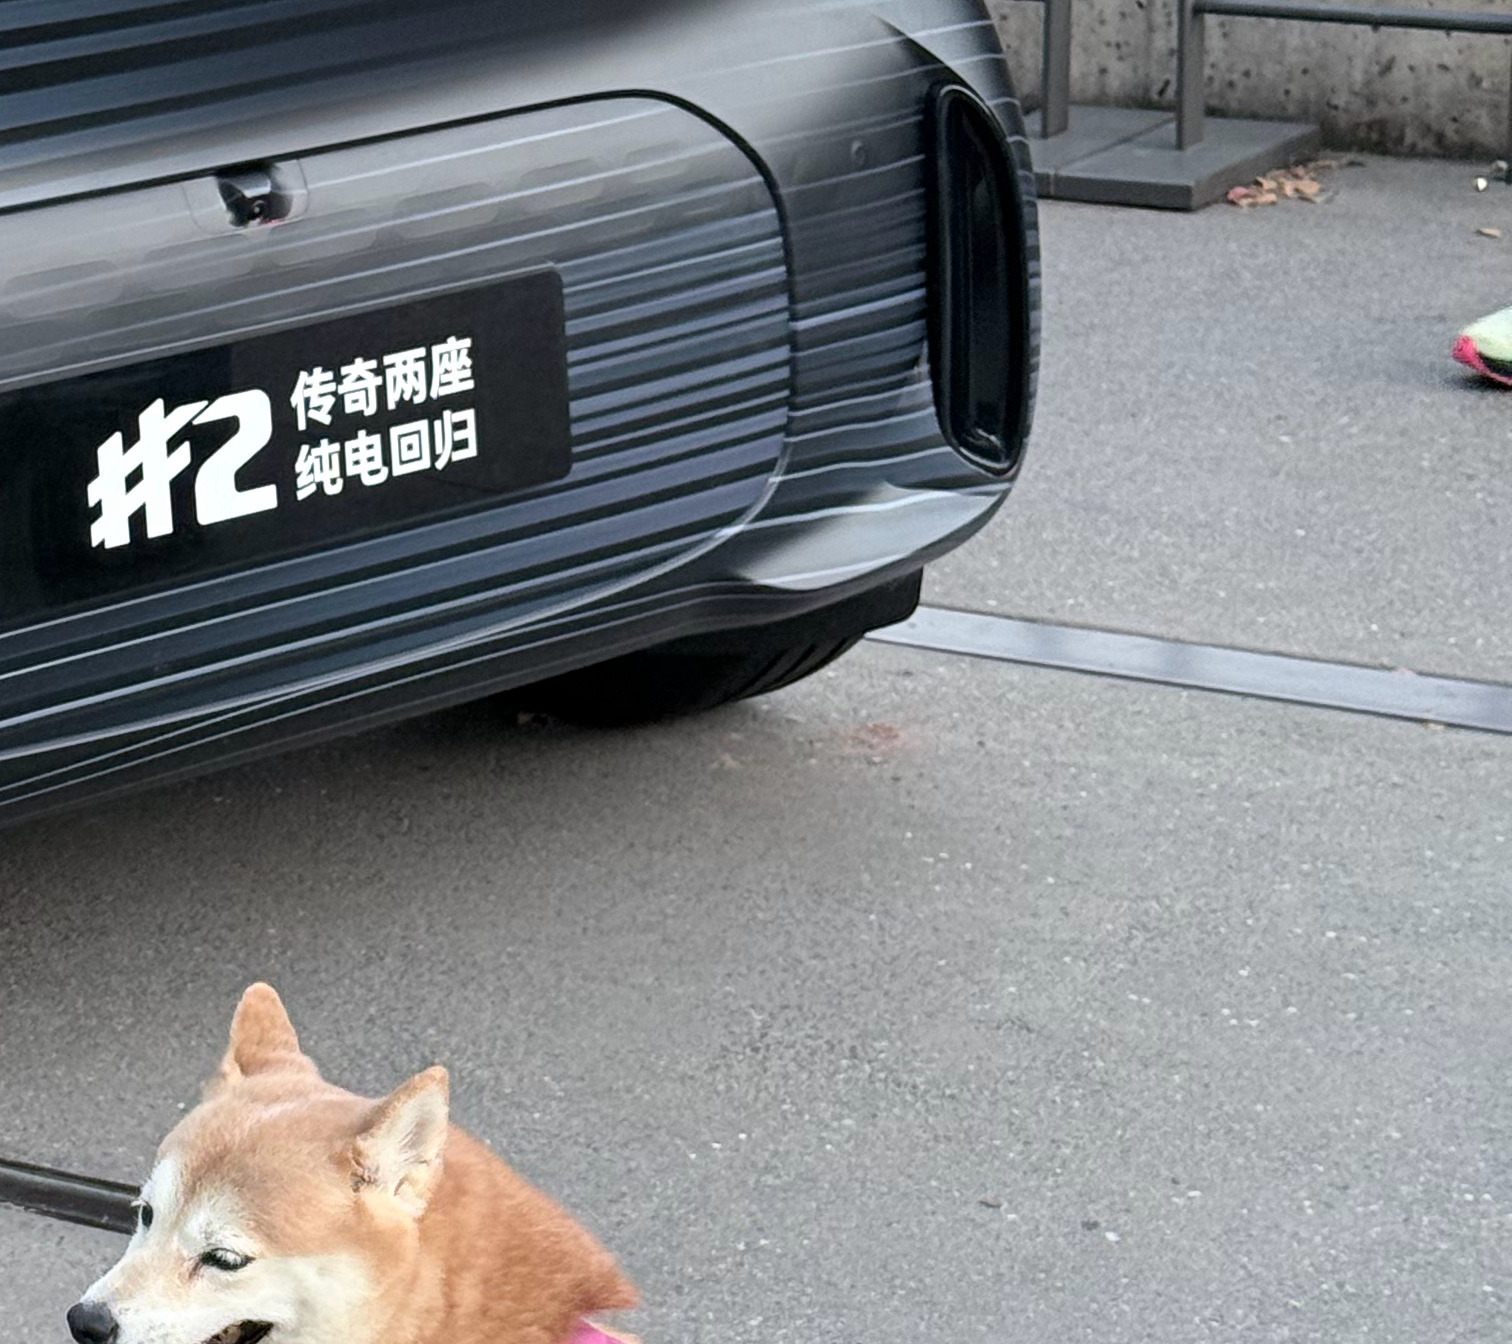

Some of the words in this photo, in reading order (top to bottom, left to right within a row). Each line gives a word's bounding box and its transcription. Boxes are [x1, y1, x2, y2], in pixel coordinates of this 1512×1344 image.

[290, 336, 476, 431] 传奇两座
[294, 408, 479, 502] 纯电回归
